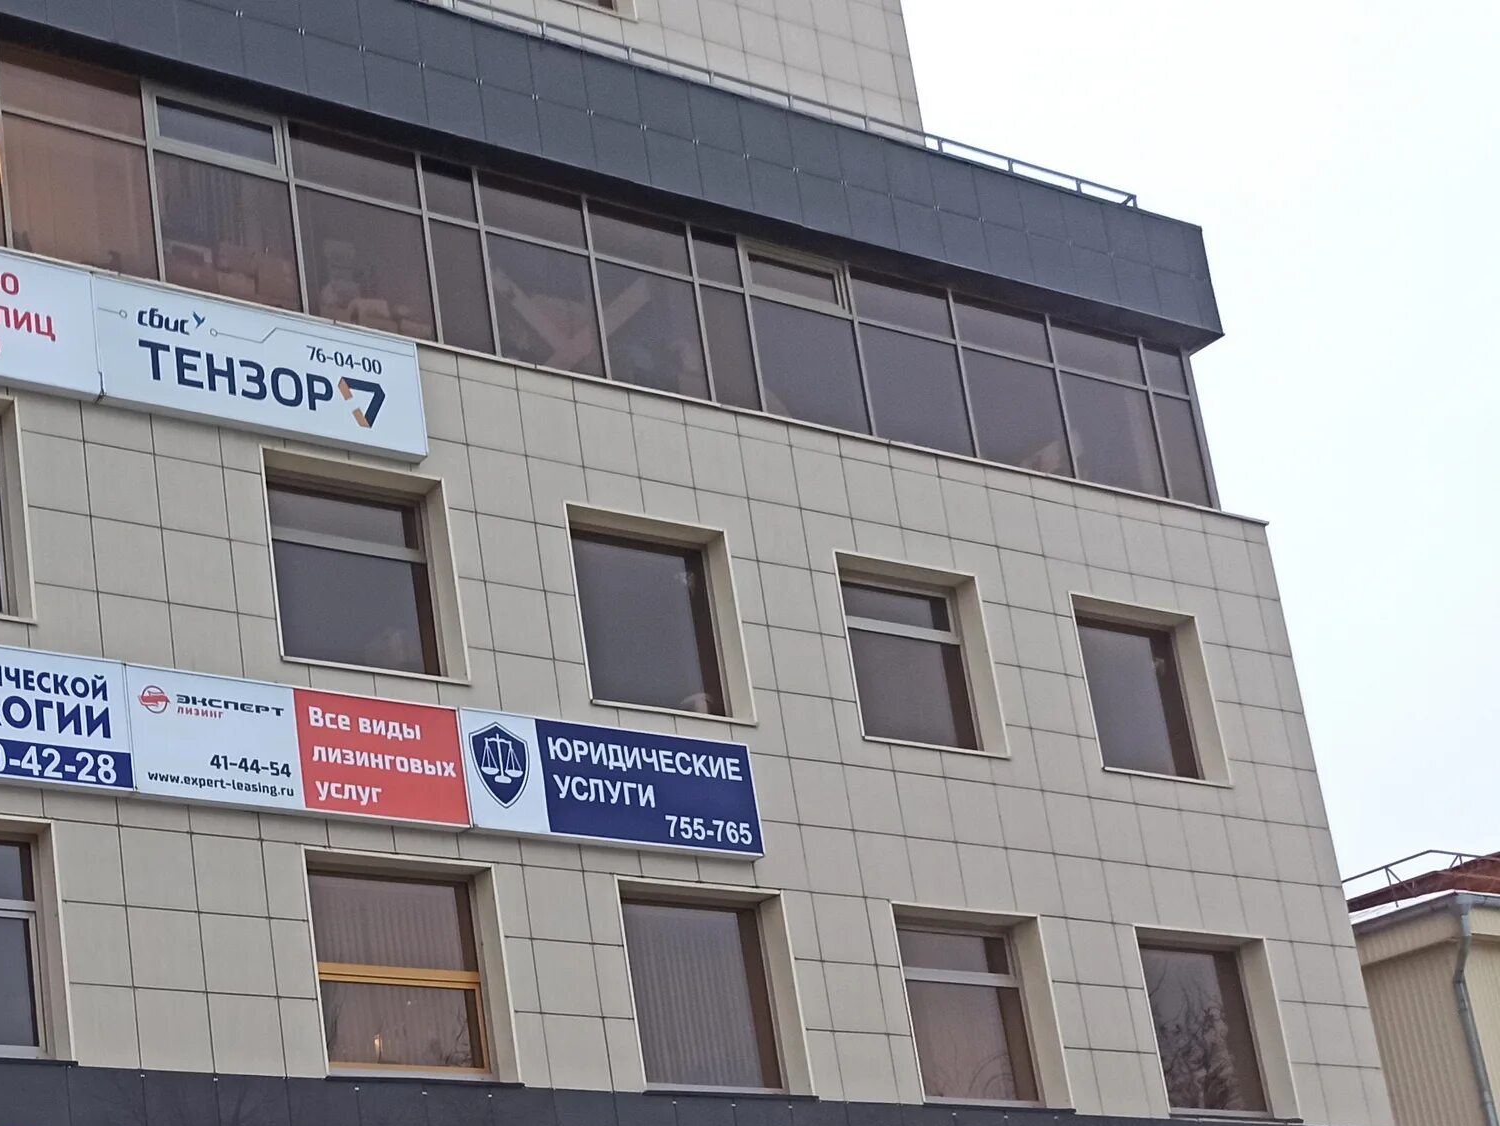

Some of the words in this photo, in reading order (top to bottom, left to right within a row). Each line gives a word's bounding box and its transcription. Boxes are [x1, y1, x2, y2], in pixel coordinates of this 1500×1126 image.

[138, 338, 334, 411] ТЕНЗОР
[306, 345, 382, 375] 76-04-00
[176, 693, 284, 717] ЭКСПЕРТ
[308, 705, 351, 731] Все
[358, 718, 421, 741] виды
[210, 754, 291, 779] 41-44-54
[312, 744, 457, 778] лизинговых
[547, 736, 743, 782] ЮРИДИЧЕСКИЕ
[147, 770, 294, 798] www.expert-leasing.ru
[315, 778, 382, 806] услуг
[552, 774, 656, 808] УСЛУГИ
[665, 814, 753, 846] 755-765
